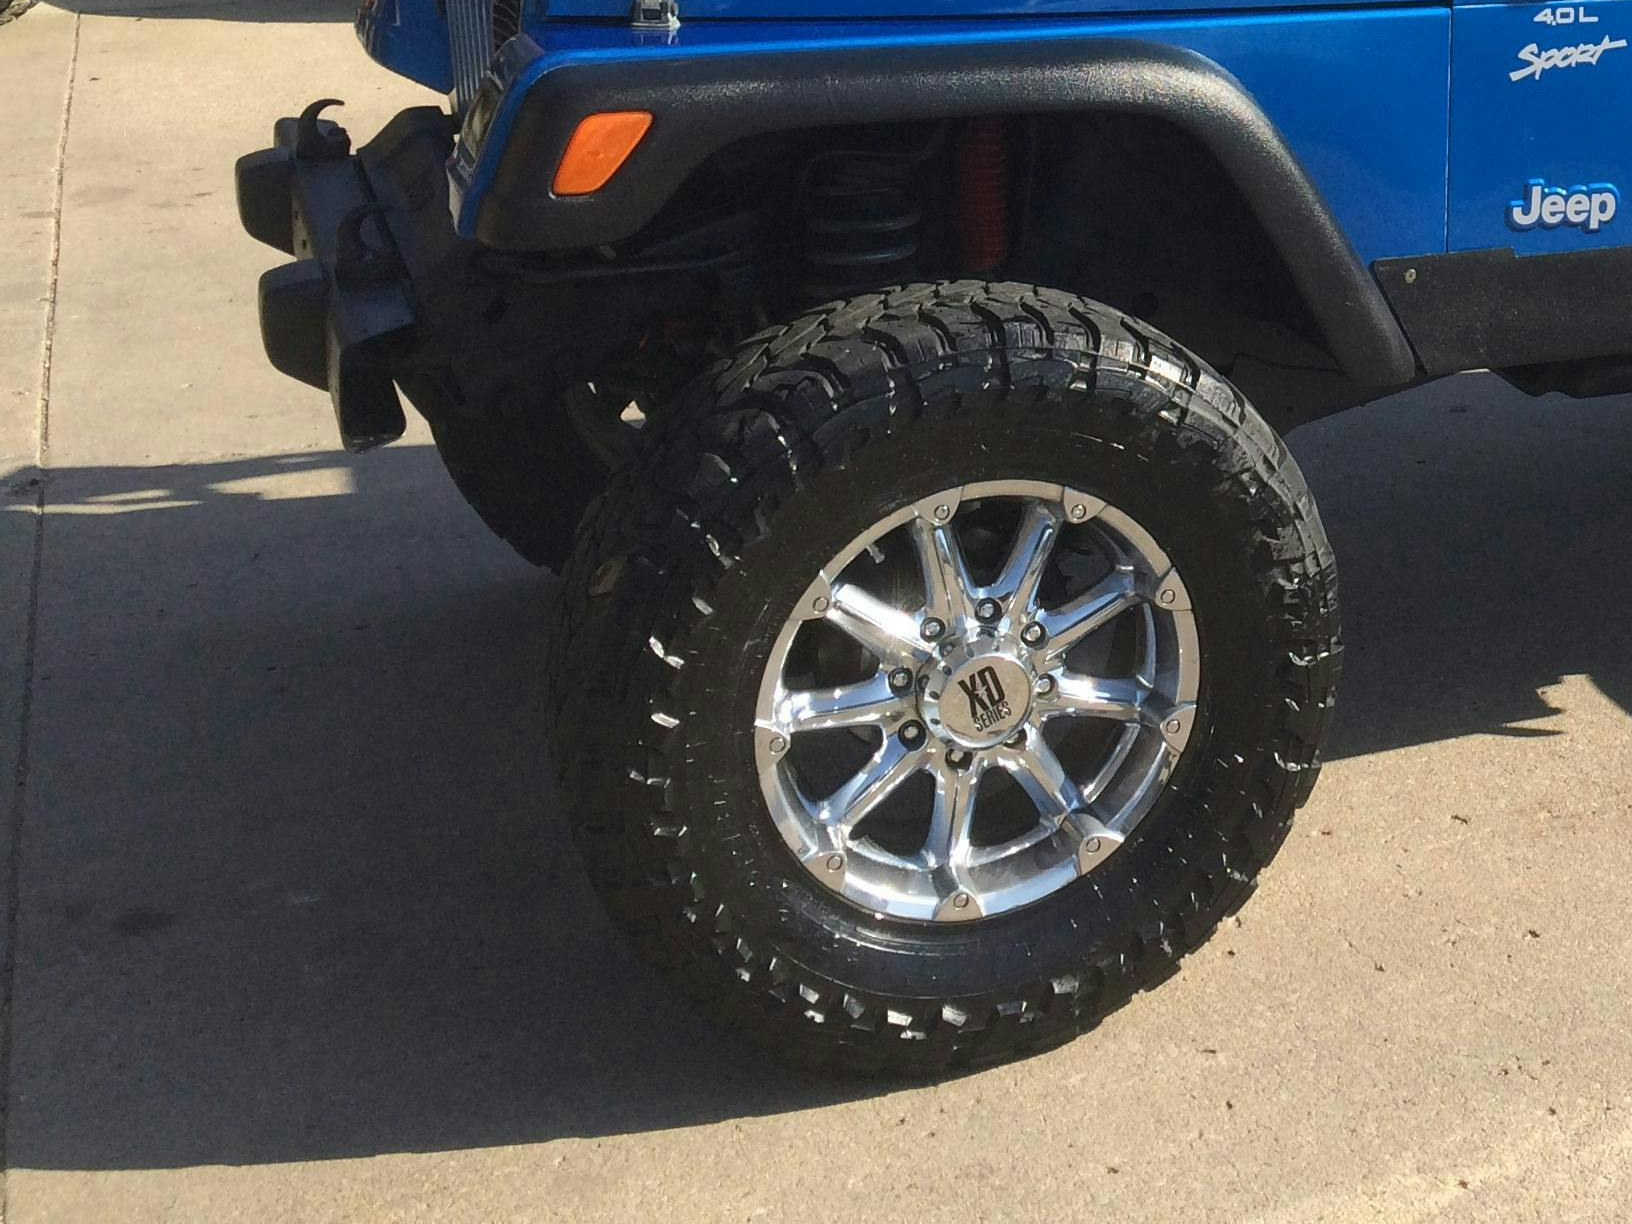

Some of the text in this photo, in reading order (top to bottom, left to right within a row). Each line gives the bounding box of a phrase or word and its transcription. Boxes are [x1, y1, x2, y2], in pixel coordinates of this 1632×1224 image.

[1512, 185, 1616, 230] Jeep
[957, 665, 1006, 718] XD
[971, 701, 1012, 732] SERIES
